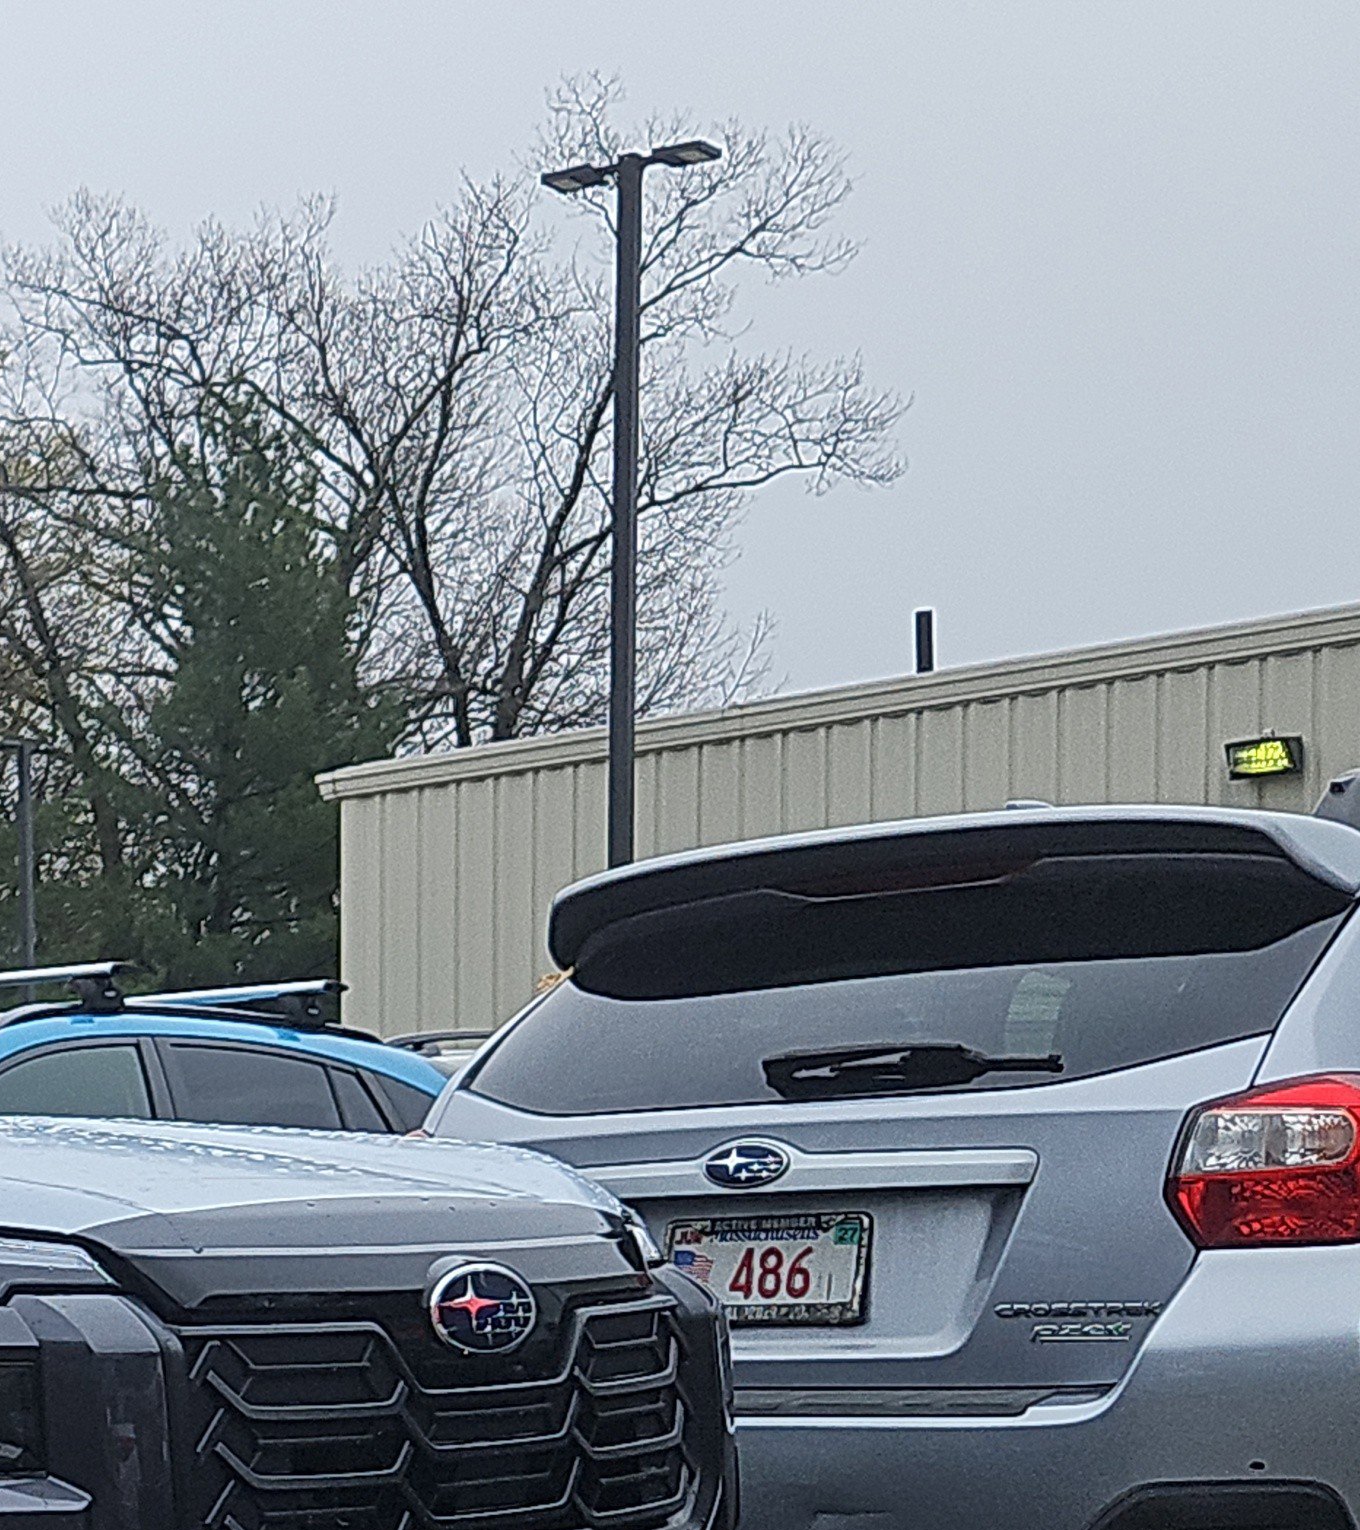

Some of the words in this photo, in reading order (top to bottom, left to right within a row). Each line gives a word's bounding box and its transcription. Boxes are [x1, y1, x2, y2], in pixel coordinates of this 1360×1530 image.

[714, 1219, 758, 1231] ACTIVE
[761, 1216, 817, 1229] MEMBER
[838, 1226, 860, 1244] 27
[729, 1246, 814, 1300] 486
[993, 1302, 1166, 1319] CROSSTREK
